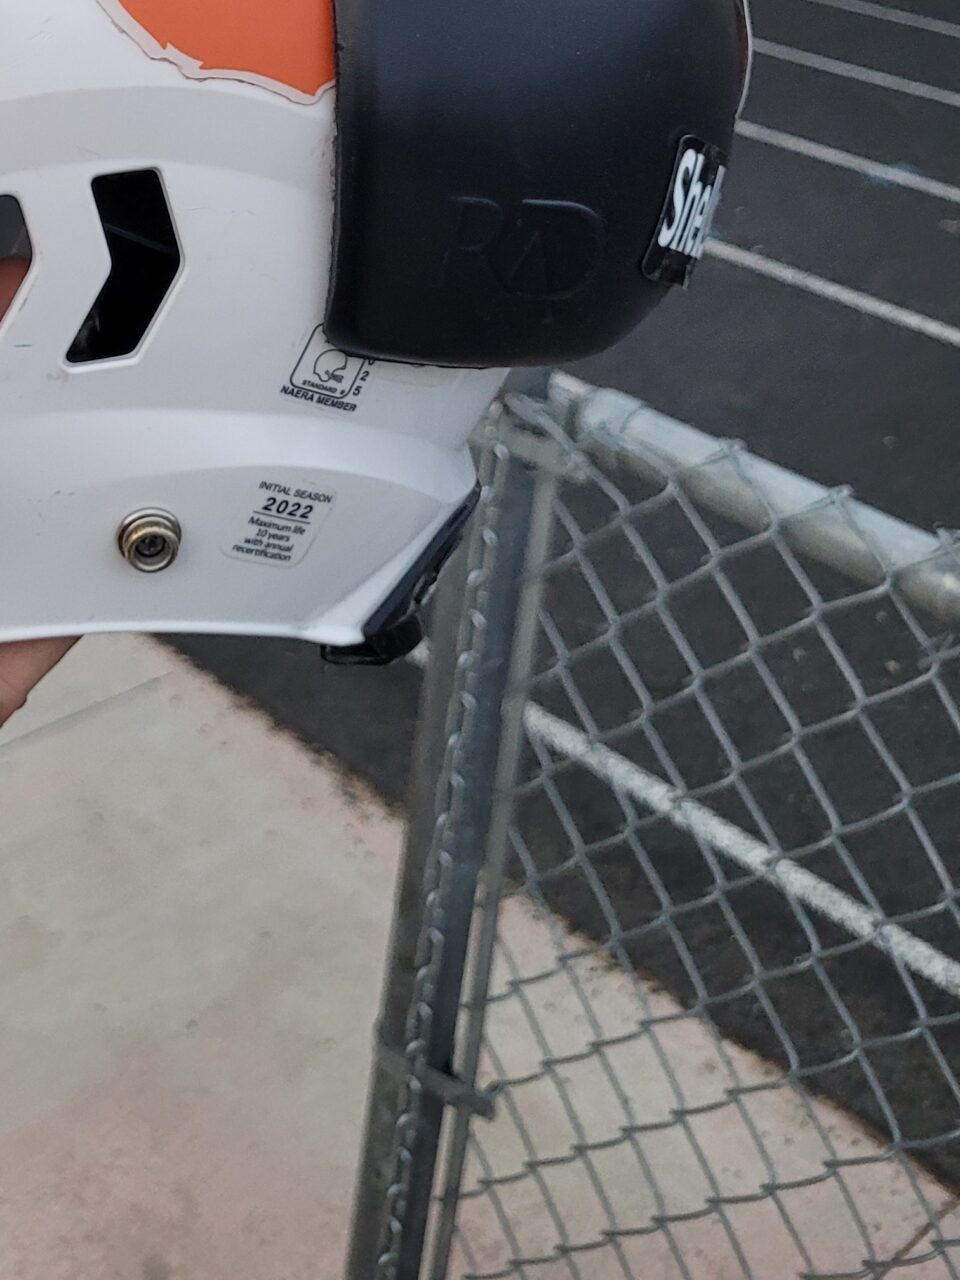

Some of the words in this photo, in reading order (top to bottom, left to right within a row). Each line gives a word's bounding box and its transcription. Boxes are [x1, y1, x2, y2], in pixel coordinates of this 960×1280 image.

[280, 385, 314, 402] NAERA
[316, 395, 357, 412] MEMBER
[258, 481, 291, 496] INITIAL
[293, 489, 333, 503] SEASON
[262, 497, 314, 519] 2022
[248, 516, 292, 532] Maximum
[292, 525, 306, 535] life
[244, 537, 264, 546] with
[264, 542, 294, 553] annual
[267, 532, 291, 542] years
[232, 544, 292, 561] recertification
